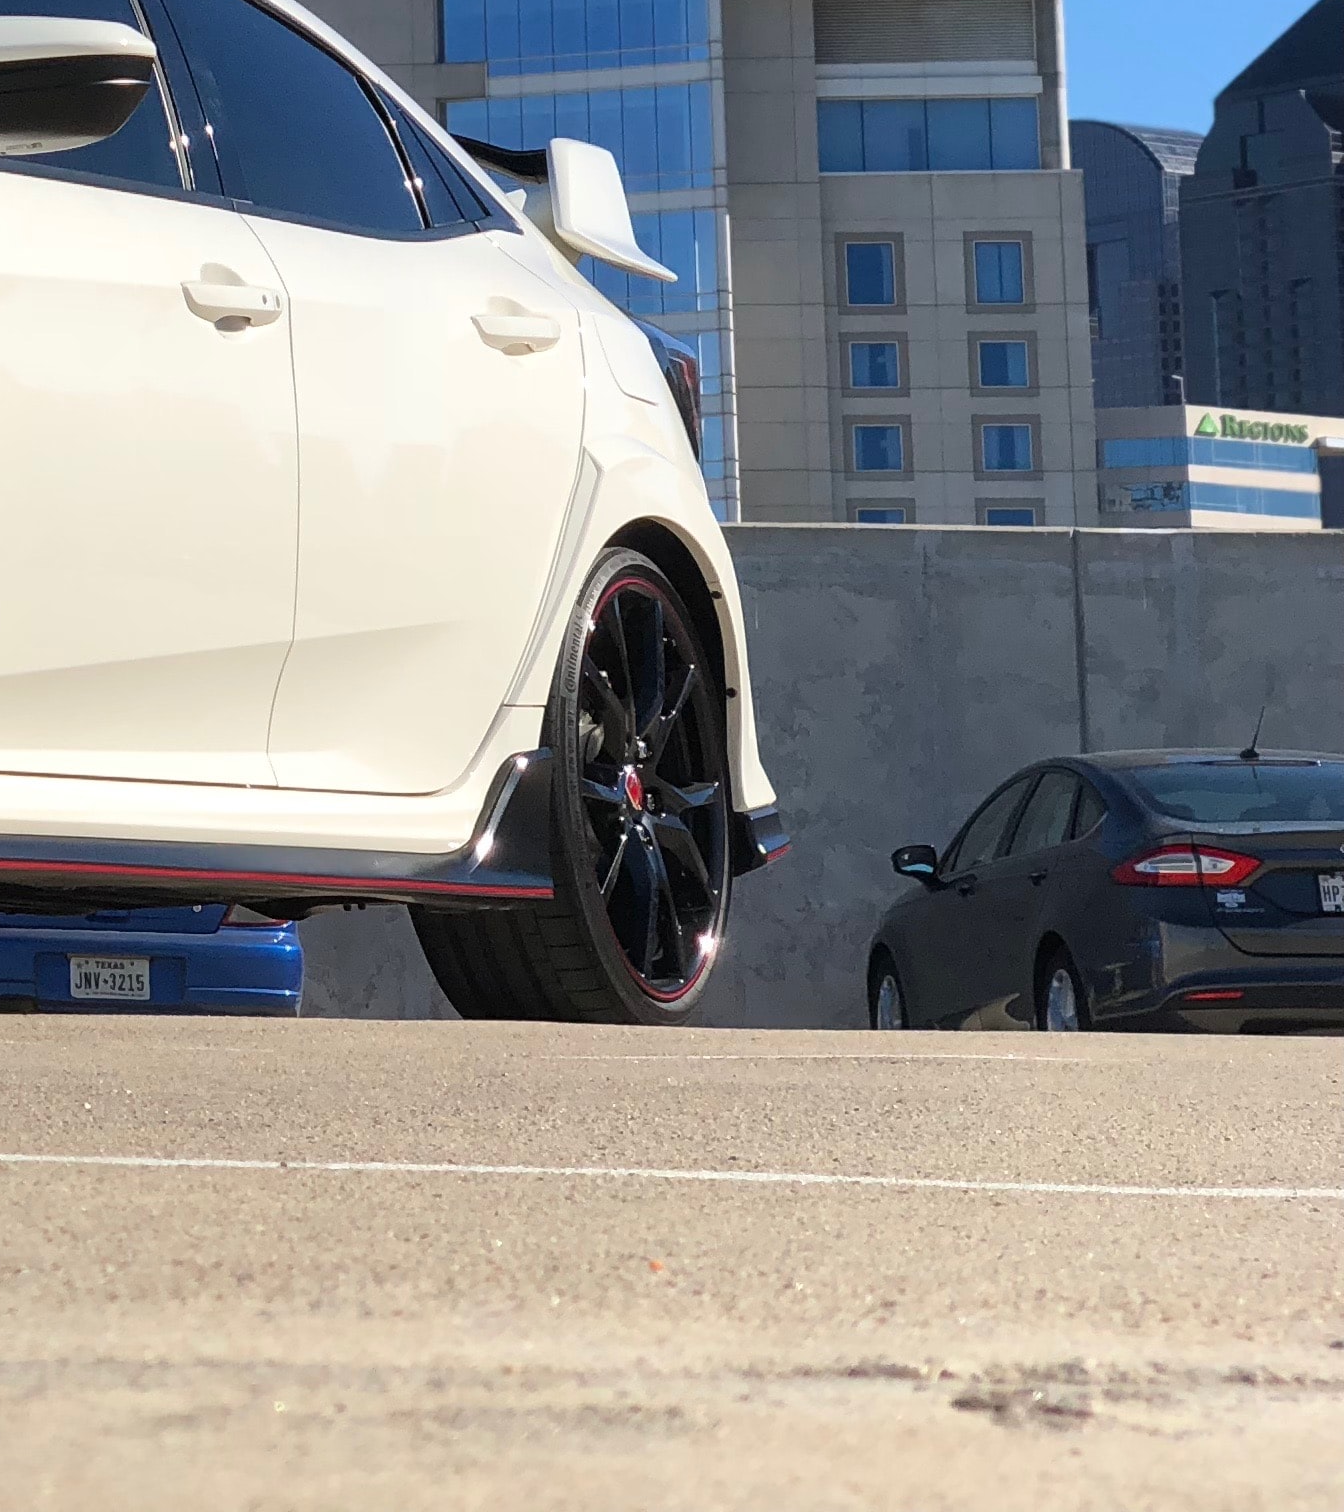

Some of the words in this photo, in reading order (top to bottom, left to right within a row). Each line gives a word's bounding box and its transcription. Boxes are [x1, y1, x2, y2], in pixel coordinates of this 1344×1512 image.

[565, 621, 583, 693] Continental
[1322, 885, 1344, 903] HP
[94, 960, 125, 970] TEXAS
